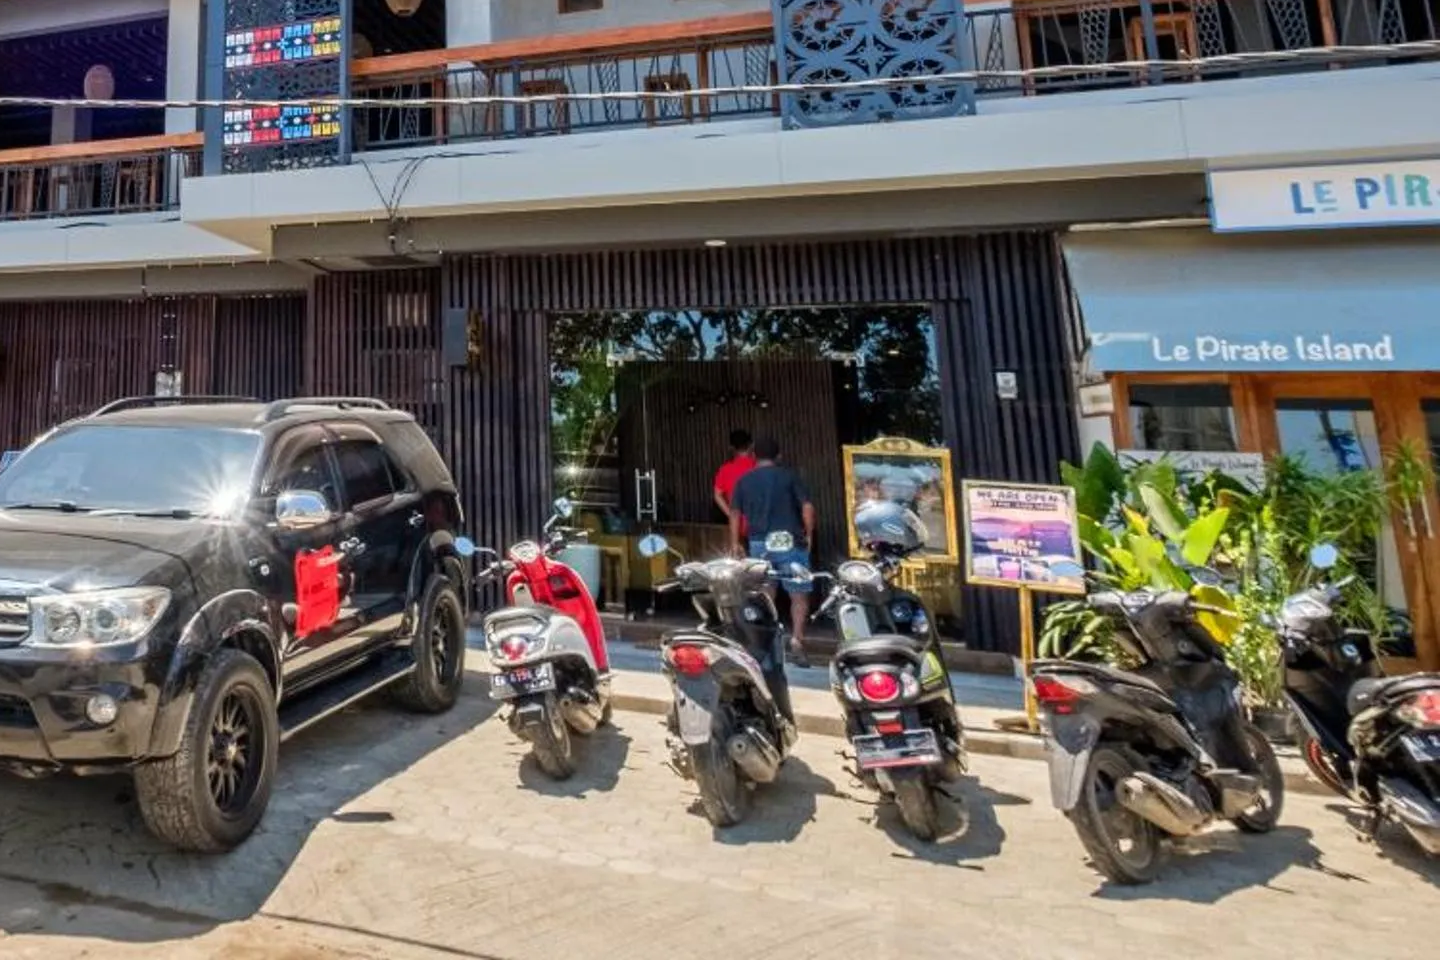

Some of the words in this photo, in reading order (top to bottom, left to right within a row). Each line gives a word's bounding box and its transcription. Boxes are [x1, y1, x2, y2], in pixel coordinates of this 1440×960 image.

[1290, 180, 1338, 214] LE
[1353, 173, 1440, 210] PIR
[1152, 337, 1191, 362] Le
[1196, 335, 1290, 362] Pirate
[1295, 335, 1395, 362] Island
[998, 490, 1020, 501] ARE
[1024, 492, 1058, 502] OPEN
